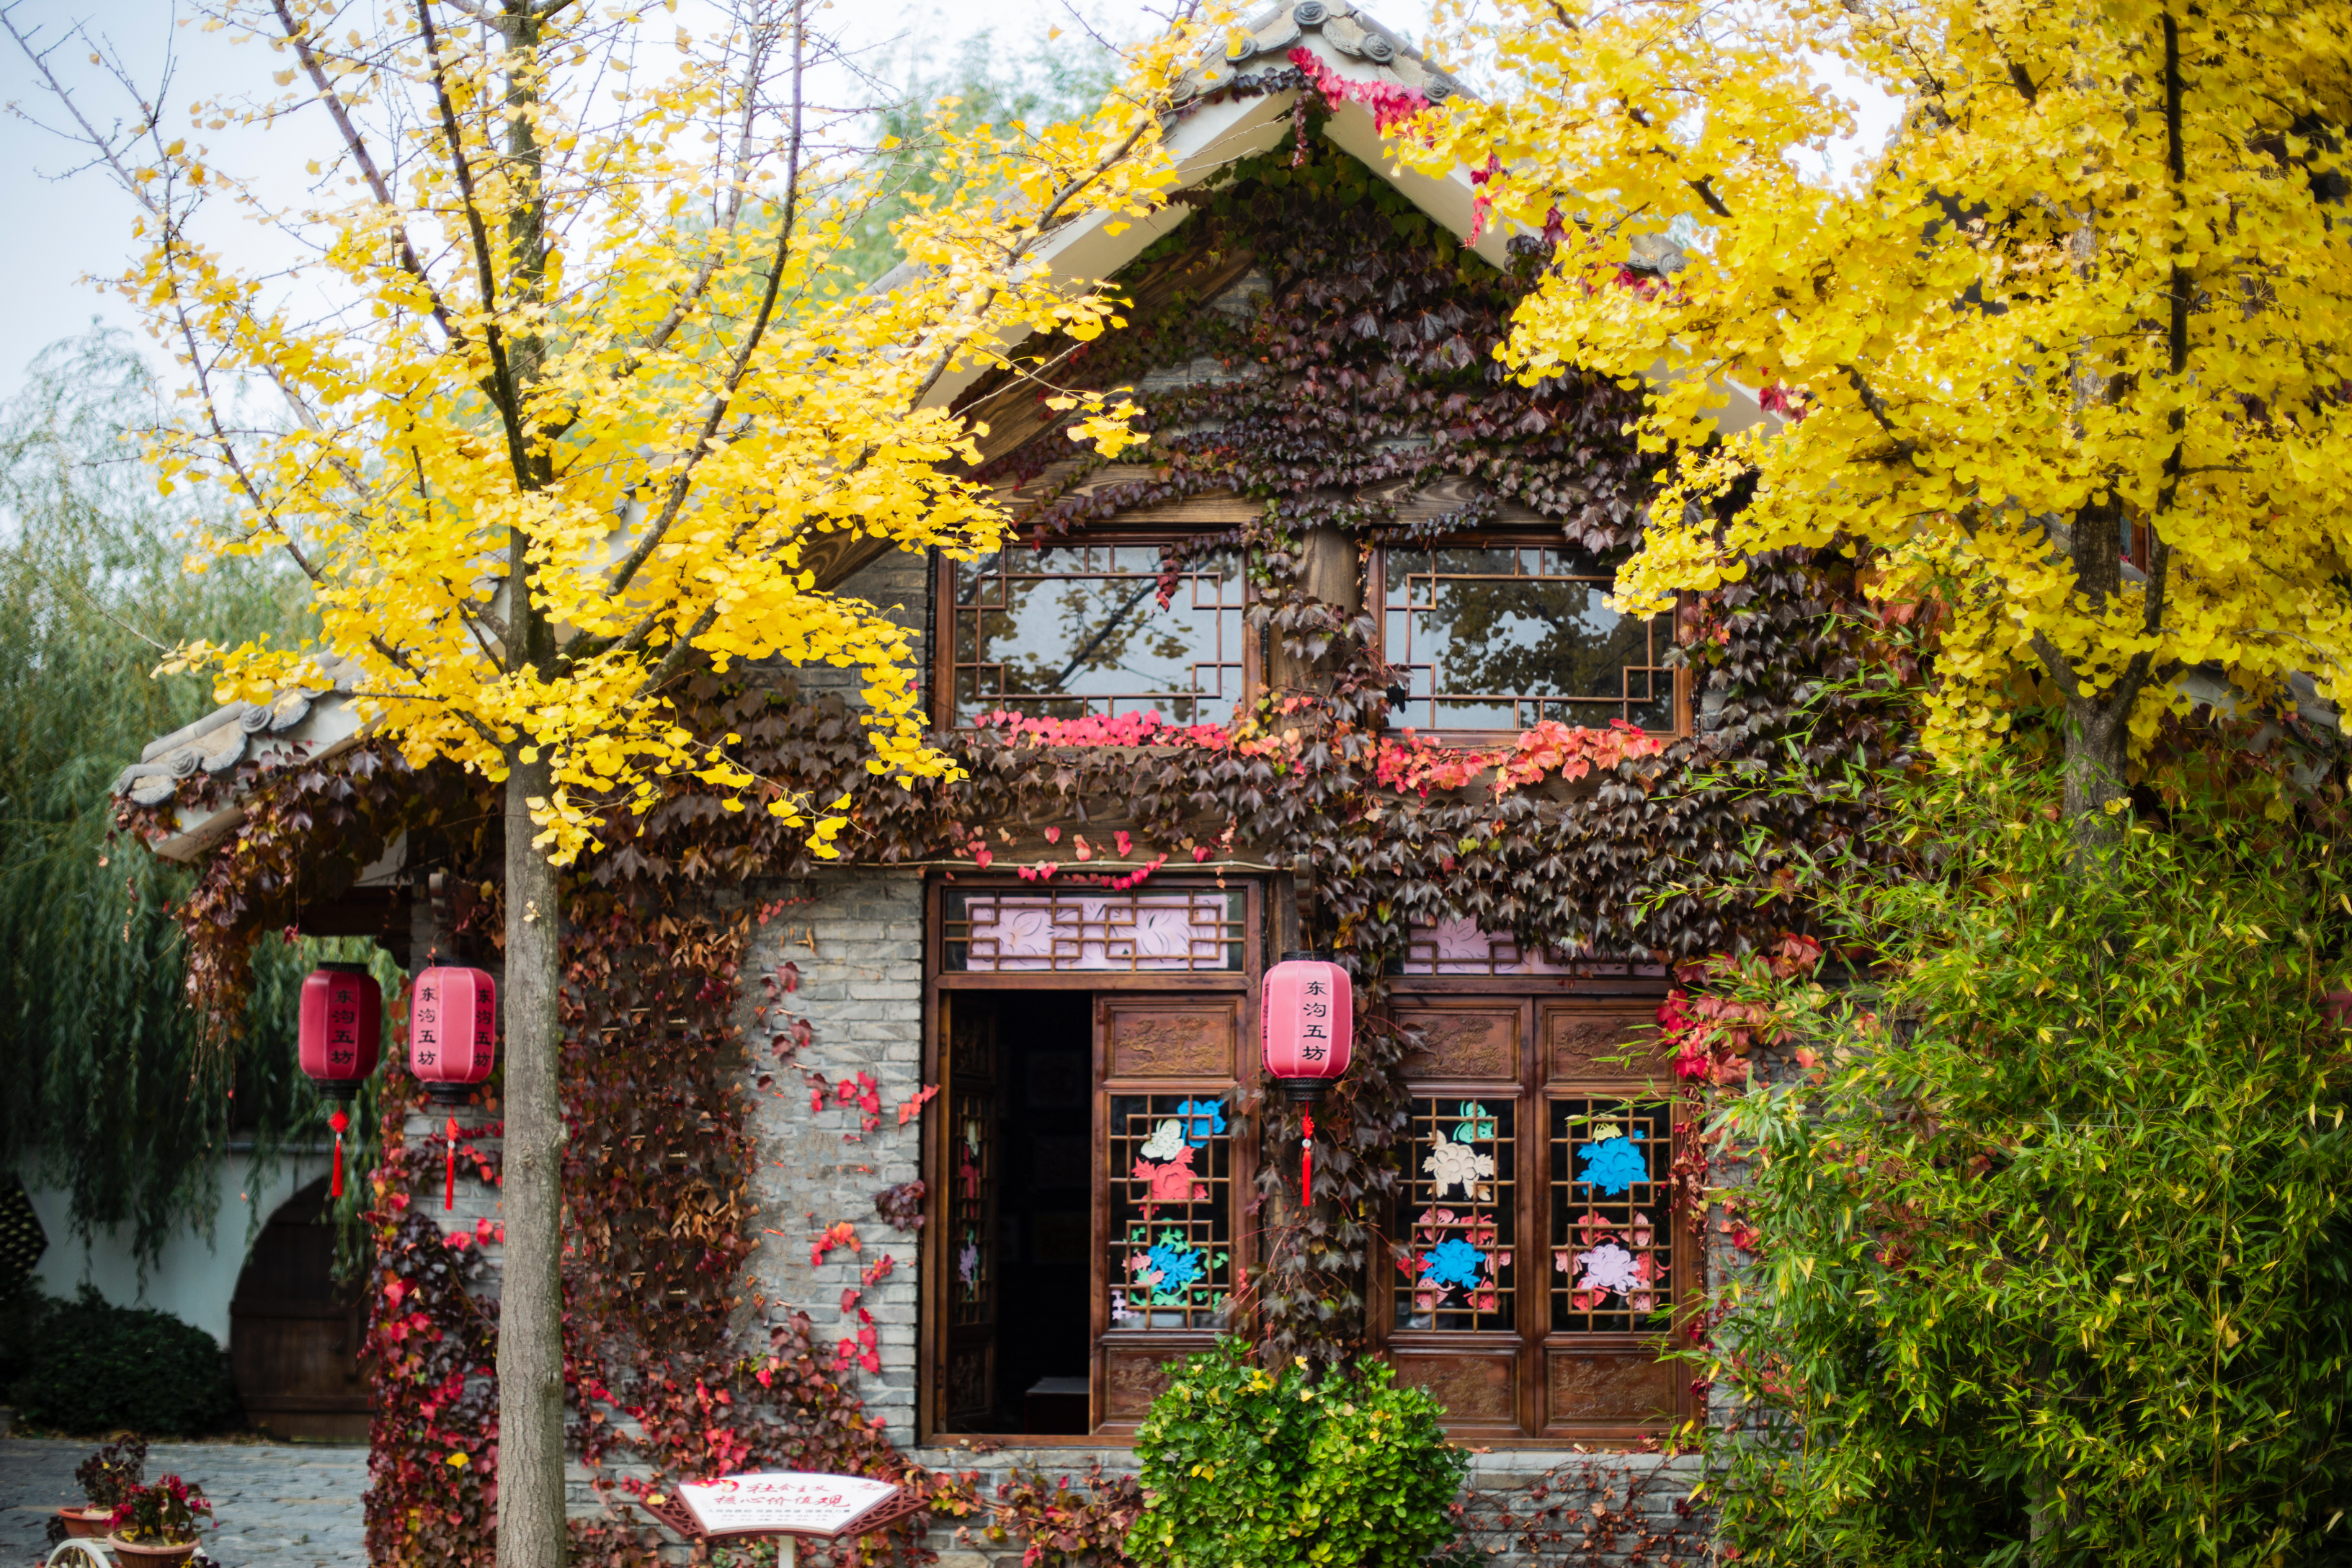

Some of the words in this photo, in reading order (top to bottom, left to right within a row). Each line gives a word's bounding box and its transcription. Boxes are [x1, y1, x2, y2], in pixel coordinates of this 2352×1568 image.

[330, 989, 355, 1065] 东沟五坊
[417, 986, 437, 1066] 东沟五坊
[474, 988, 492, 1067] 东沟五坊
[1301, 980, 1328, 1061] 东沟五坊
[713, 1494, 851, 1507] 核心价值观
[747, 1482, 830, 1494] 社会主义
